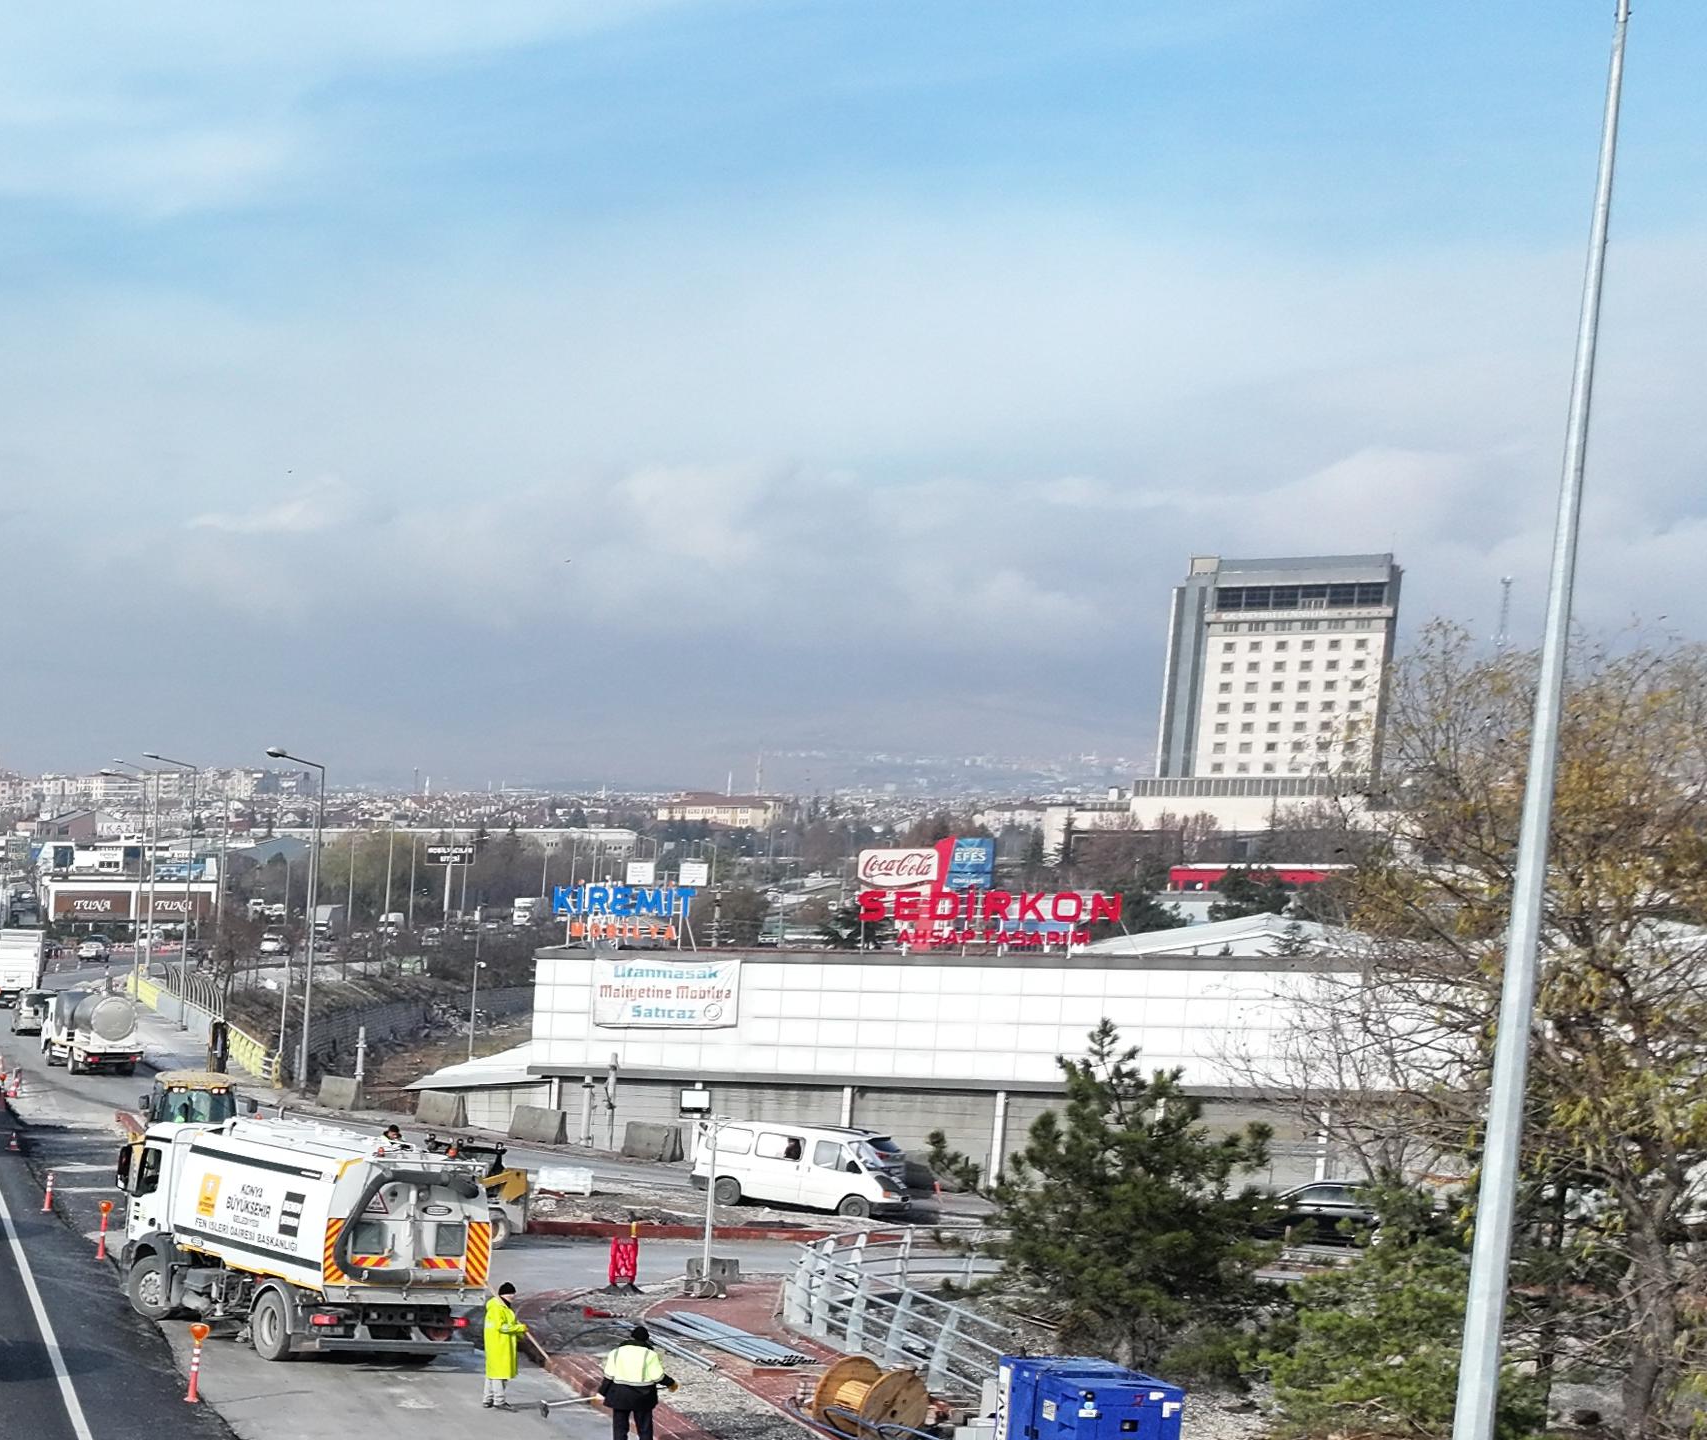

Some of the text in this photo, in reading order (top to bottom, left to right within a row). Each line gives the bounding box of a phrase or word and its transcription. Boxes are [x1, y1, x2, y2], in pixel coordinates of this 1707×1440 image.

[954, 851, 986, 862] EFES
[863, 853, 935, 878] Coca-Cola
[73, 899, 112, 911] TUNA
[858, 883, 1123, 923] SEDİRKON
[613, 965, 719, 979] Utanmasak
[599, 984, 733, 1003] Maliyetine Mobilya
[194, 1217, 207, 1228] FEN
